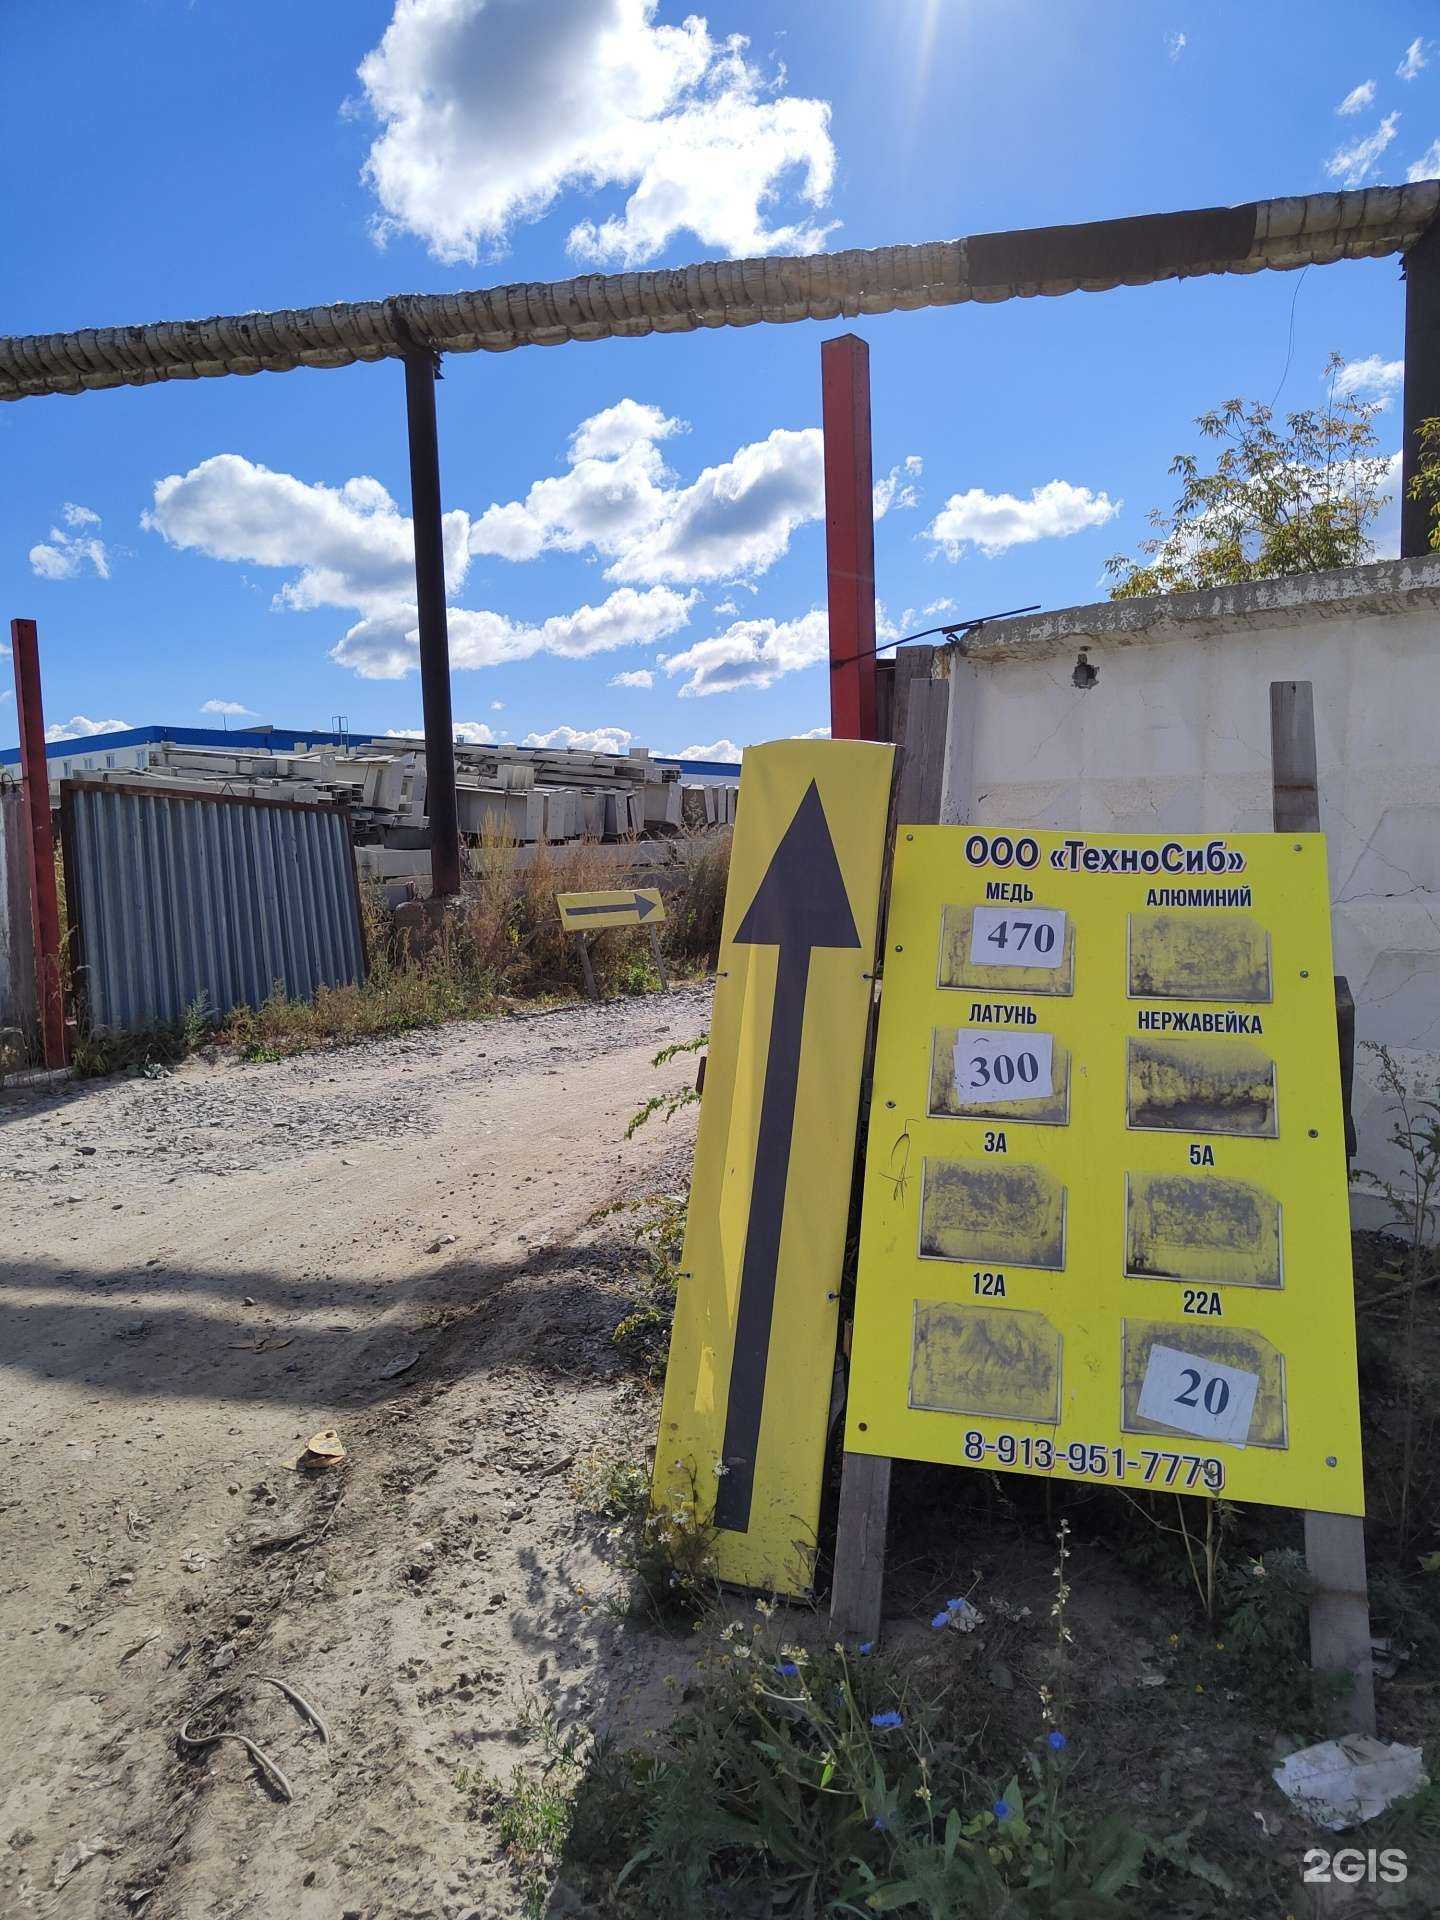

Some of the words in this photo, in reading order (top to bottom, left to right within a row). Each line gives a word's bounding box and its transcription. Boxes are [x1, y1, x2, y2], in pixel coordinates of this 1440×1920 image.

[964, 835, 1040, 868] ООО
[1050, 838, 1246, 874] «ТехноСиб»
[985, 882, 1034, 903] МЕДЬ
[1146, 885, 1253, 908] АЛЮМИНИЙ
[987, 920, 1055, 953] 470
[968, 1004, 1038, 1026] ЛАТУНЬ
[1137, 1010, 1263, 1036] НЕРЖАВЕЙКА
[970, 1052, 1039, 1088] 300
[1189, 1144, 1215, 1167] 5А
[973, 1273, 1006, 1297] 12А
[1183, 1290, 1222, 1316] 22А
[1174, 1368, 1230, 1415] 20
[964, 1431, 1226, 1490] 8-913-951-7779
